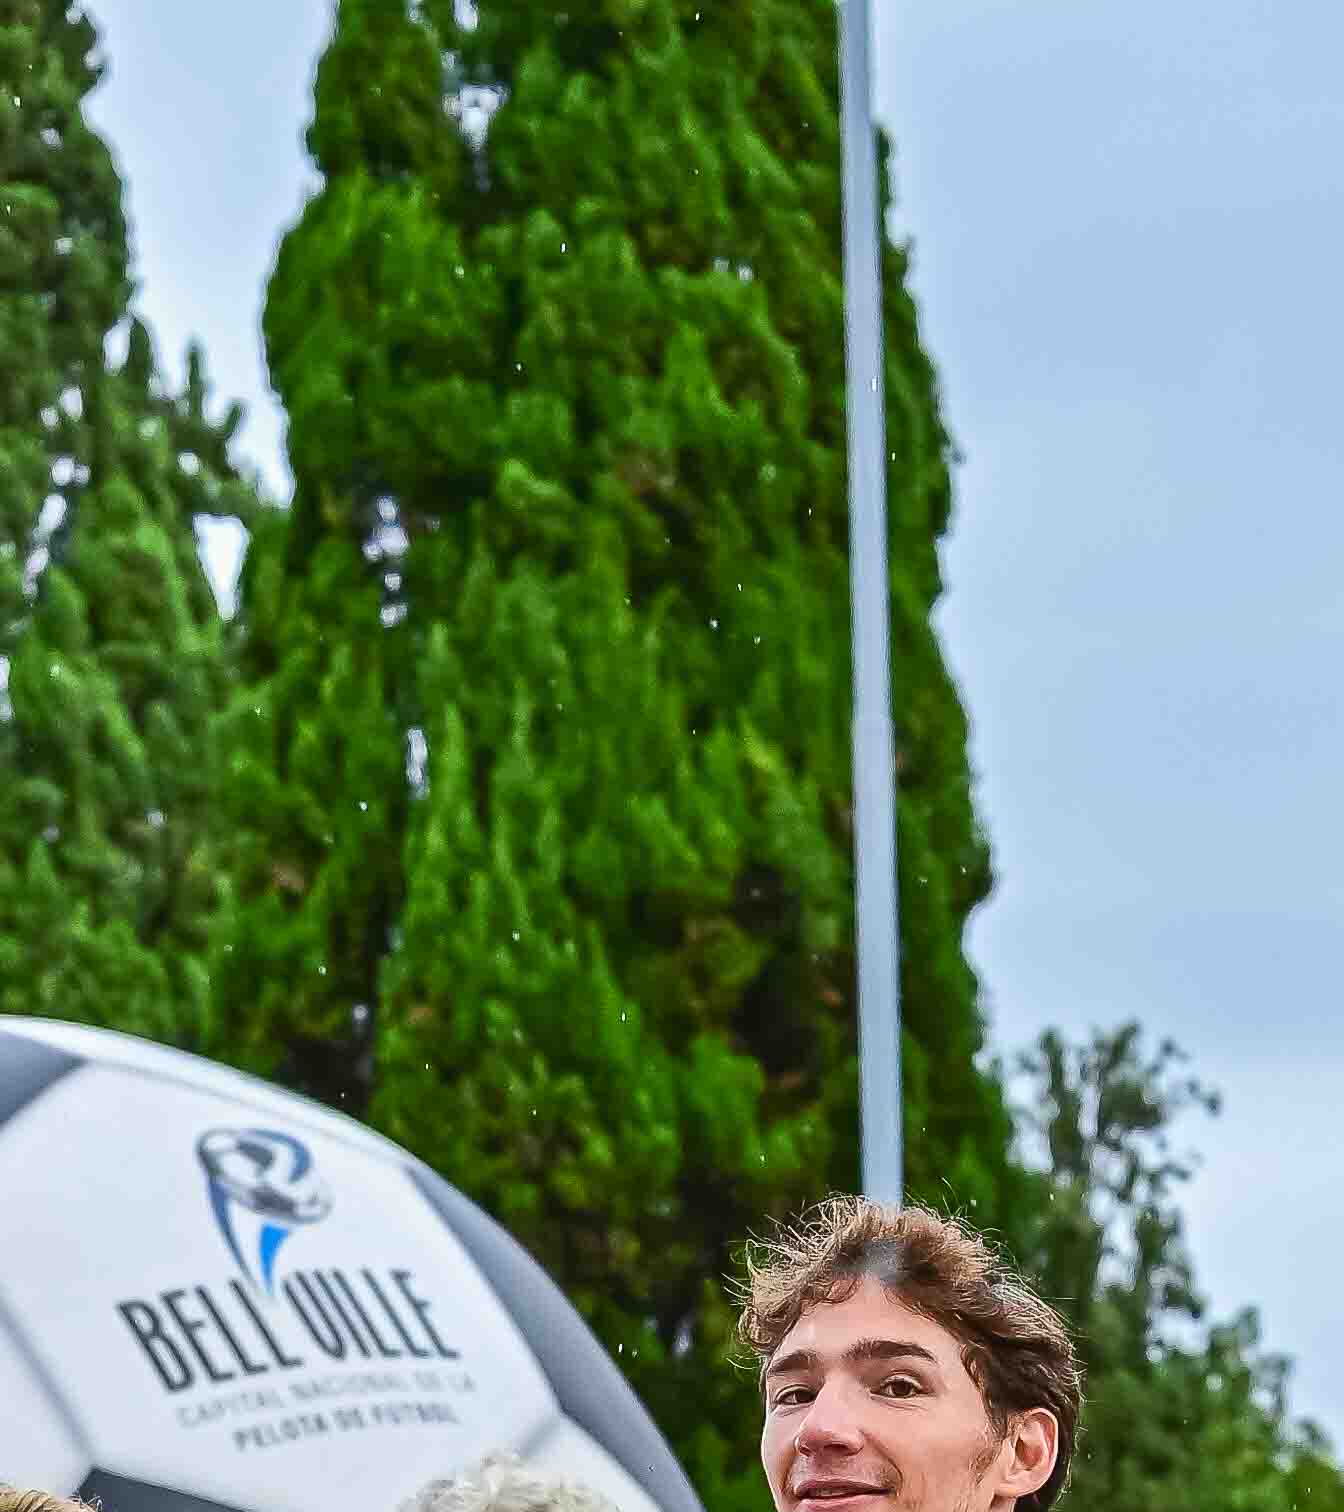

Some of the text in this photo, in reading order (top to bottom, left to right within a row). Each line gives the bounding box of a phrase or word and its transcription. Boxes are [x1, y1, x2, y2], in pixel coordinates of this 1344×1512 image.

[115, 1277, 303, 1394] BELL
[177, 1389, 284, 1429] CAPITAL
[290, 1373, 406, 1398] NACIONAL
[448, 1373, 476, 1393] LA
[233, 1410, 329, 1451] PELOTA
[332, 1406, 366, 1430] DE
